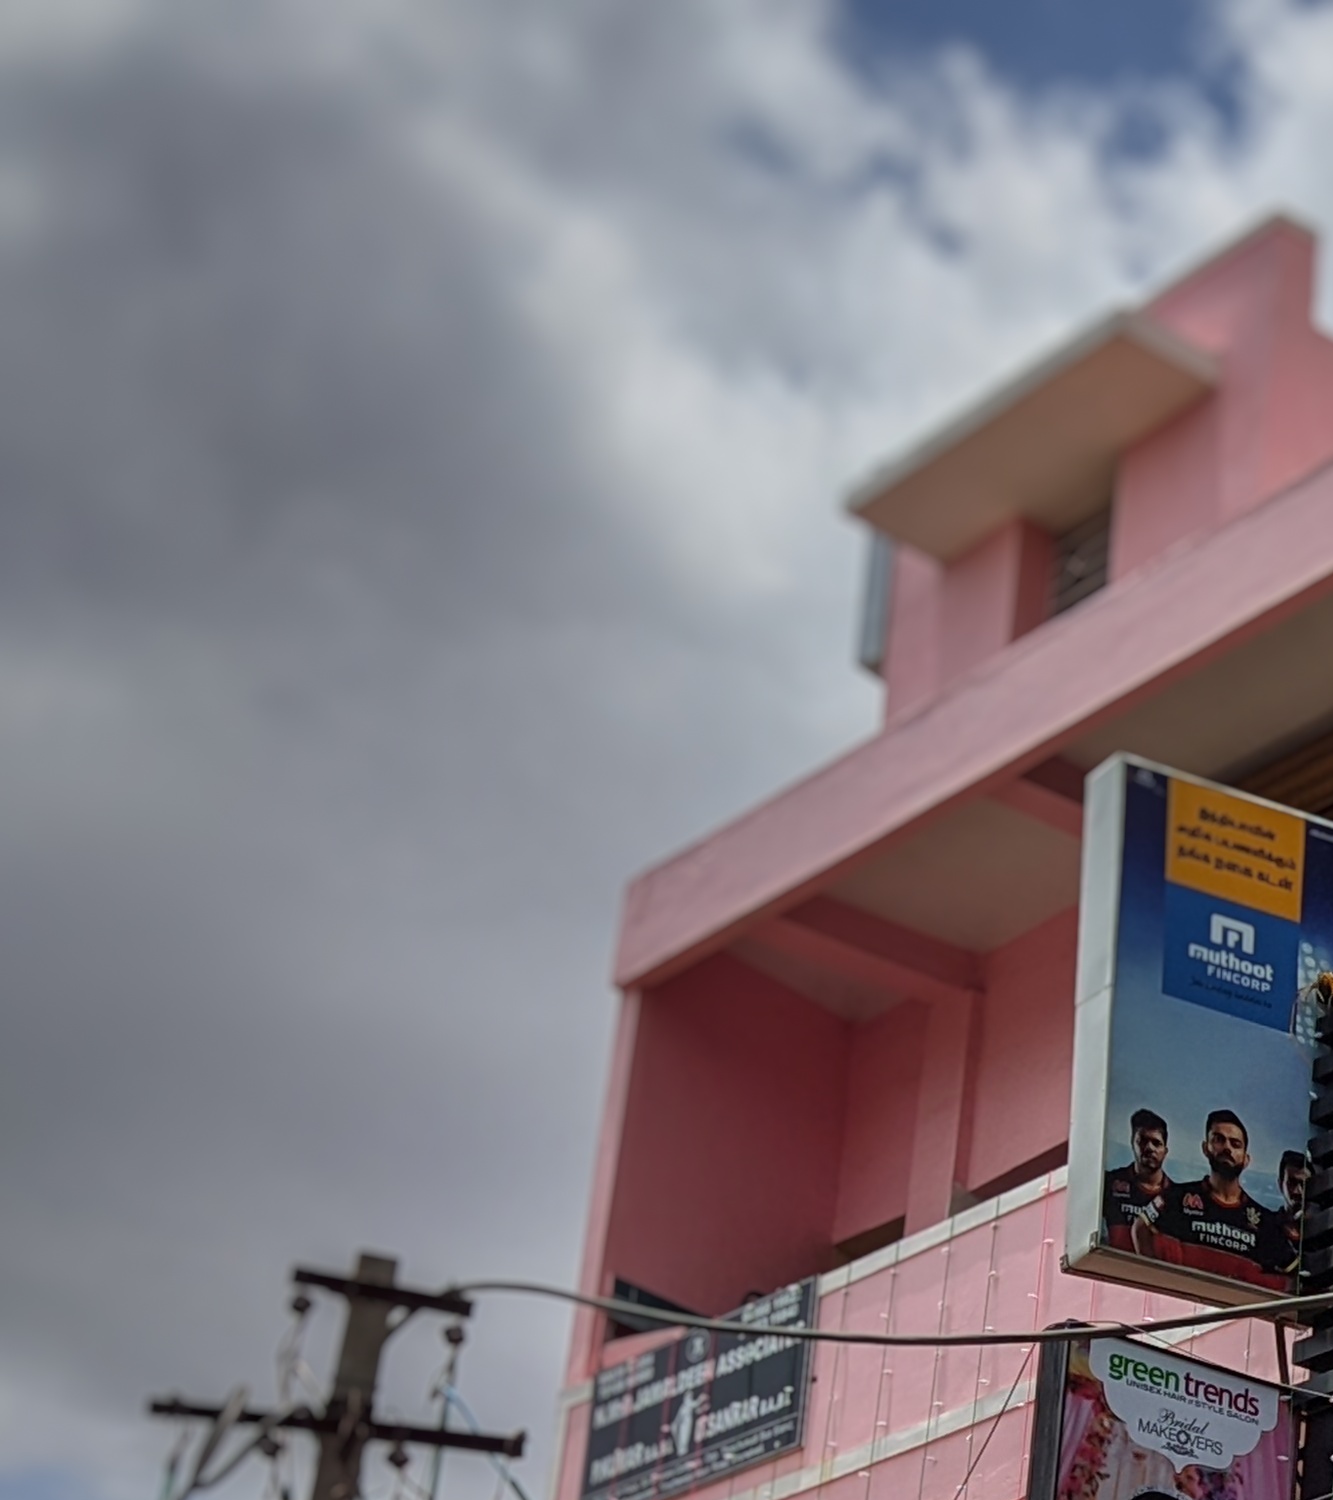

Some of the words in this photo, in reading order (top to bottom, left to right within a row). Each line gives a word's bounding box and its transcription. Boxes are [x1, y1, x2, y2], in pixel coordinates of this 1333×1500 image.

[1187, 942, 1275, 982] muthoot
[1205, 965, 1272, 994] FINCORP
[1191, 1219, 1257, 1247] muthoot
[1198, 1231, 1249, 1252] FINCORP
[1108, 1352, 1181, 1393] green
[1183, 1371, 1260, 1418] trends
[1125, 1378, 1163, 1396] UNISEX
[1163, 1390, 1188, 1404] HAIR
[1194, 1400, 1226, 1416] STYLE
[1226, 1409, 1260, 1427] SALON
[1137, 1417, 1224, 1456] MAKEOVERS
[1157, 1407, 1212, 1436] Bridal
